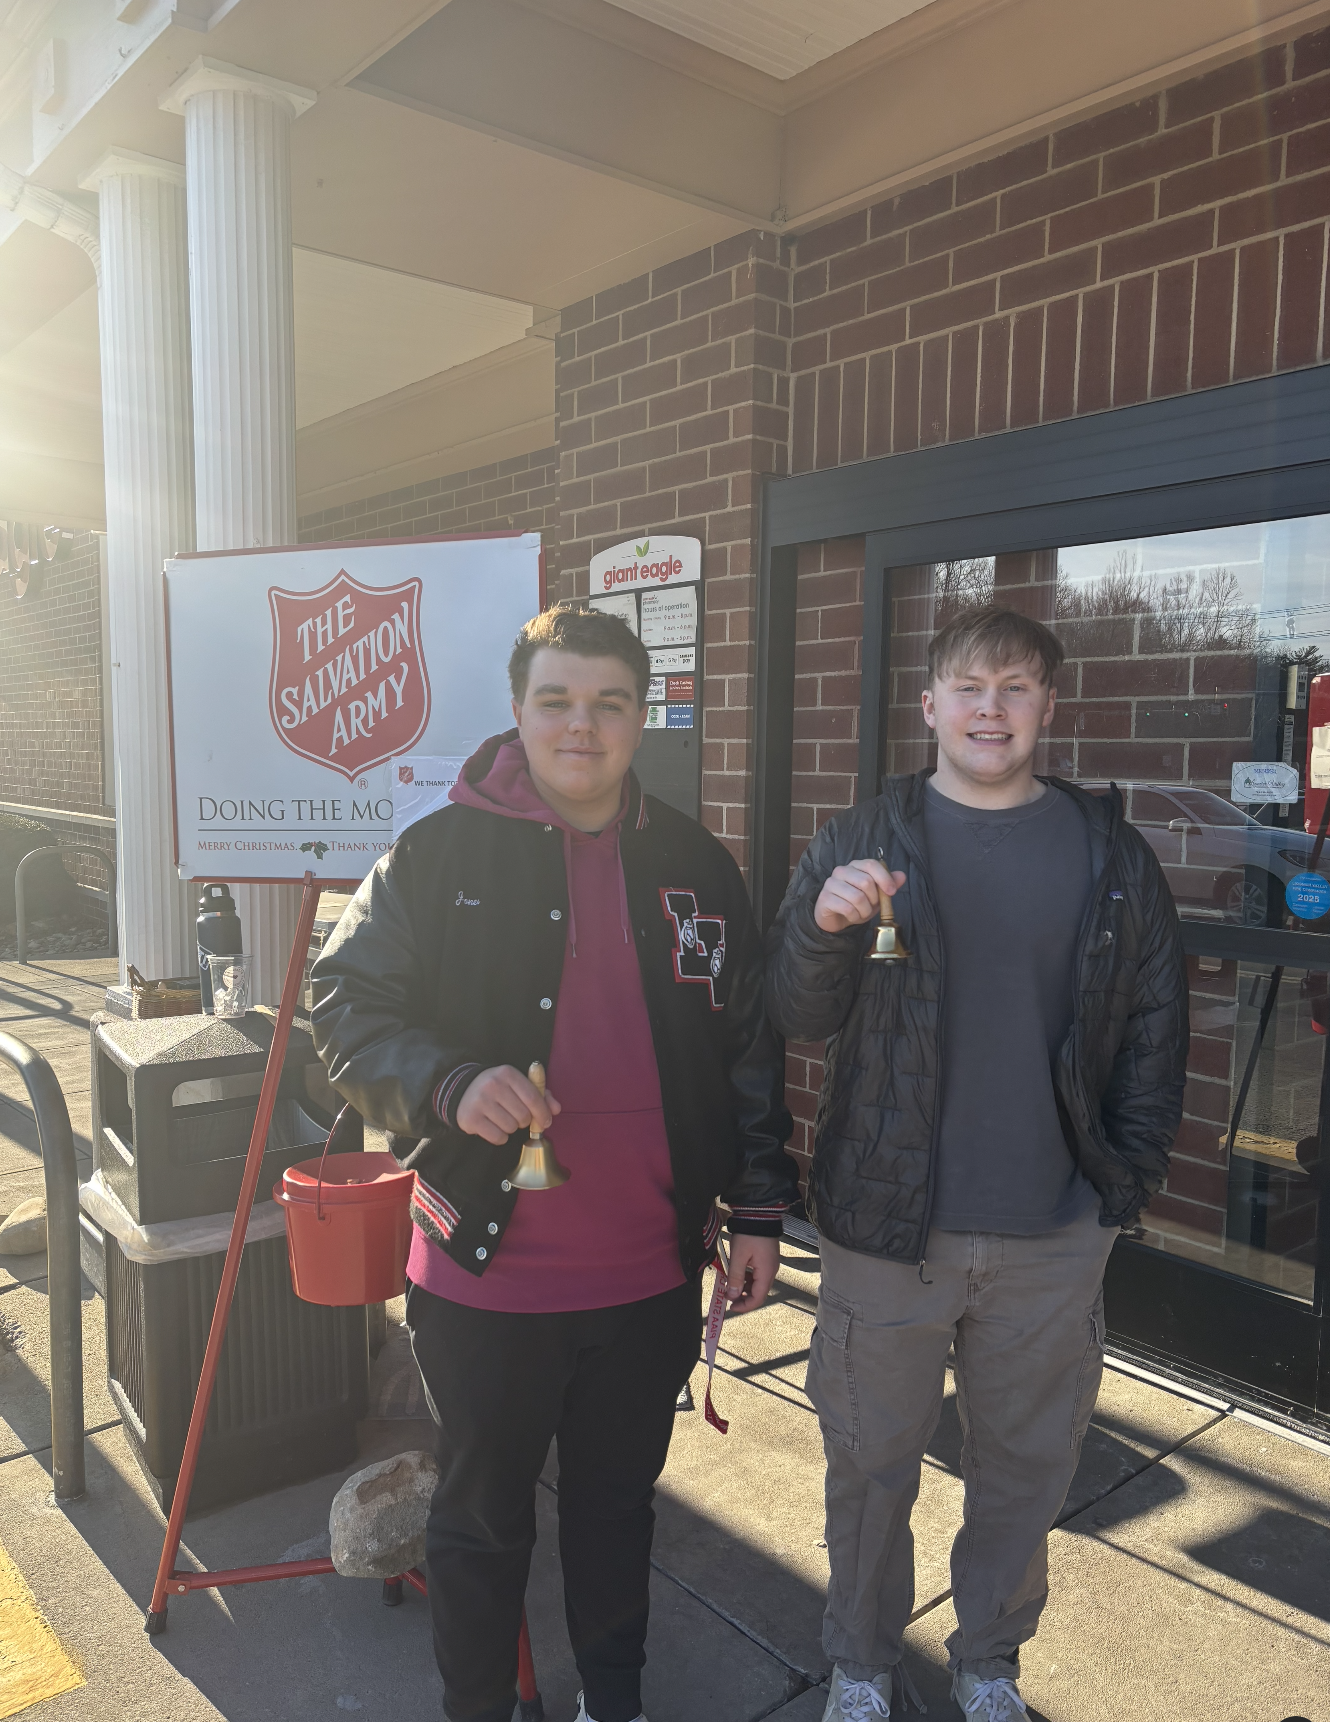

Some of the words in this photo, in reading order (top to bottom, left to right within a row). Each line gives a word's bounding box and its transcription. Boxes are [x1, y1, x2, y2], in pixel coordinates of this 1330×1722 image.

[603, 561, 639, 591] giant
[640, 554, 683, 583] eagle
[296, 593, 356, 664] THE
[280, 601, 411, 729] SALVATION
[329, 661, 409, 757] ARMY
[197, 797, 286, 821] DOING
[291, 799, 343, 821] THE
[350, 798, 394, 821] MO
[1297, 893, 1320, 903] 2025
